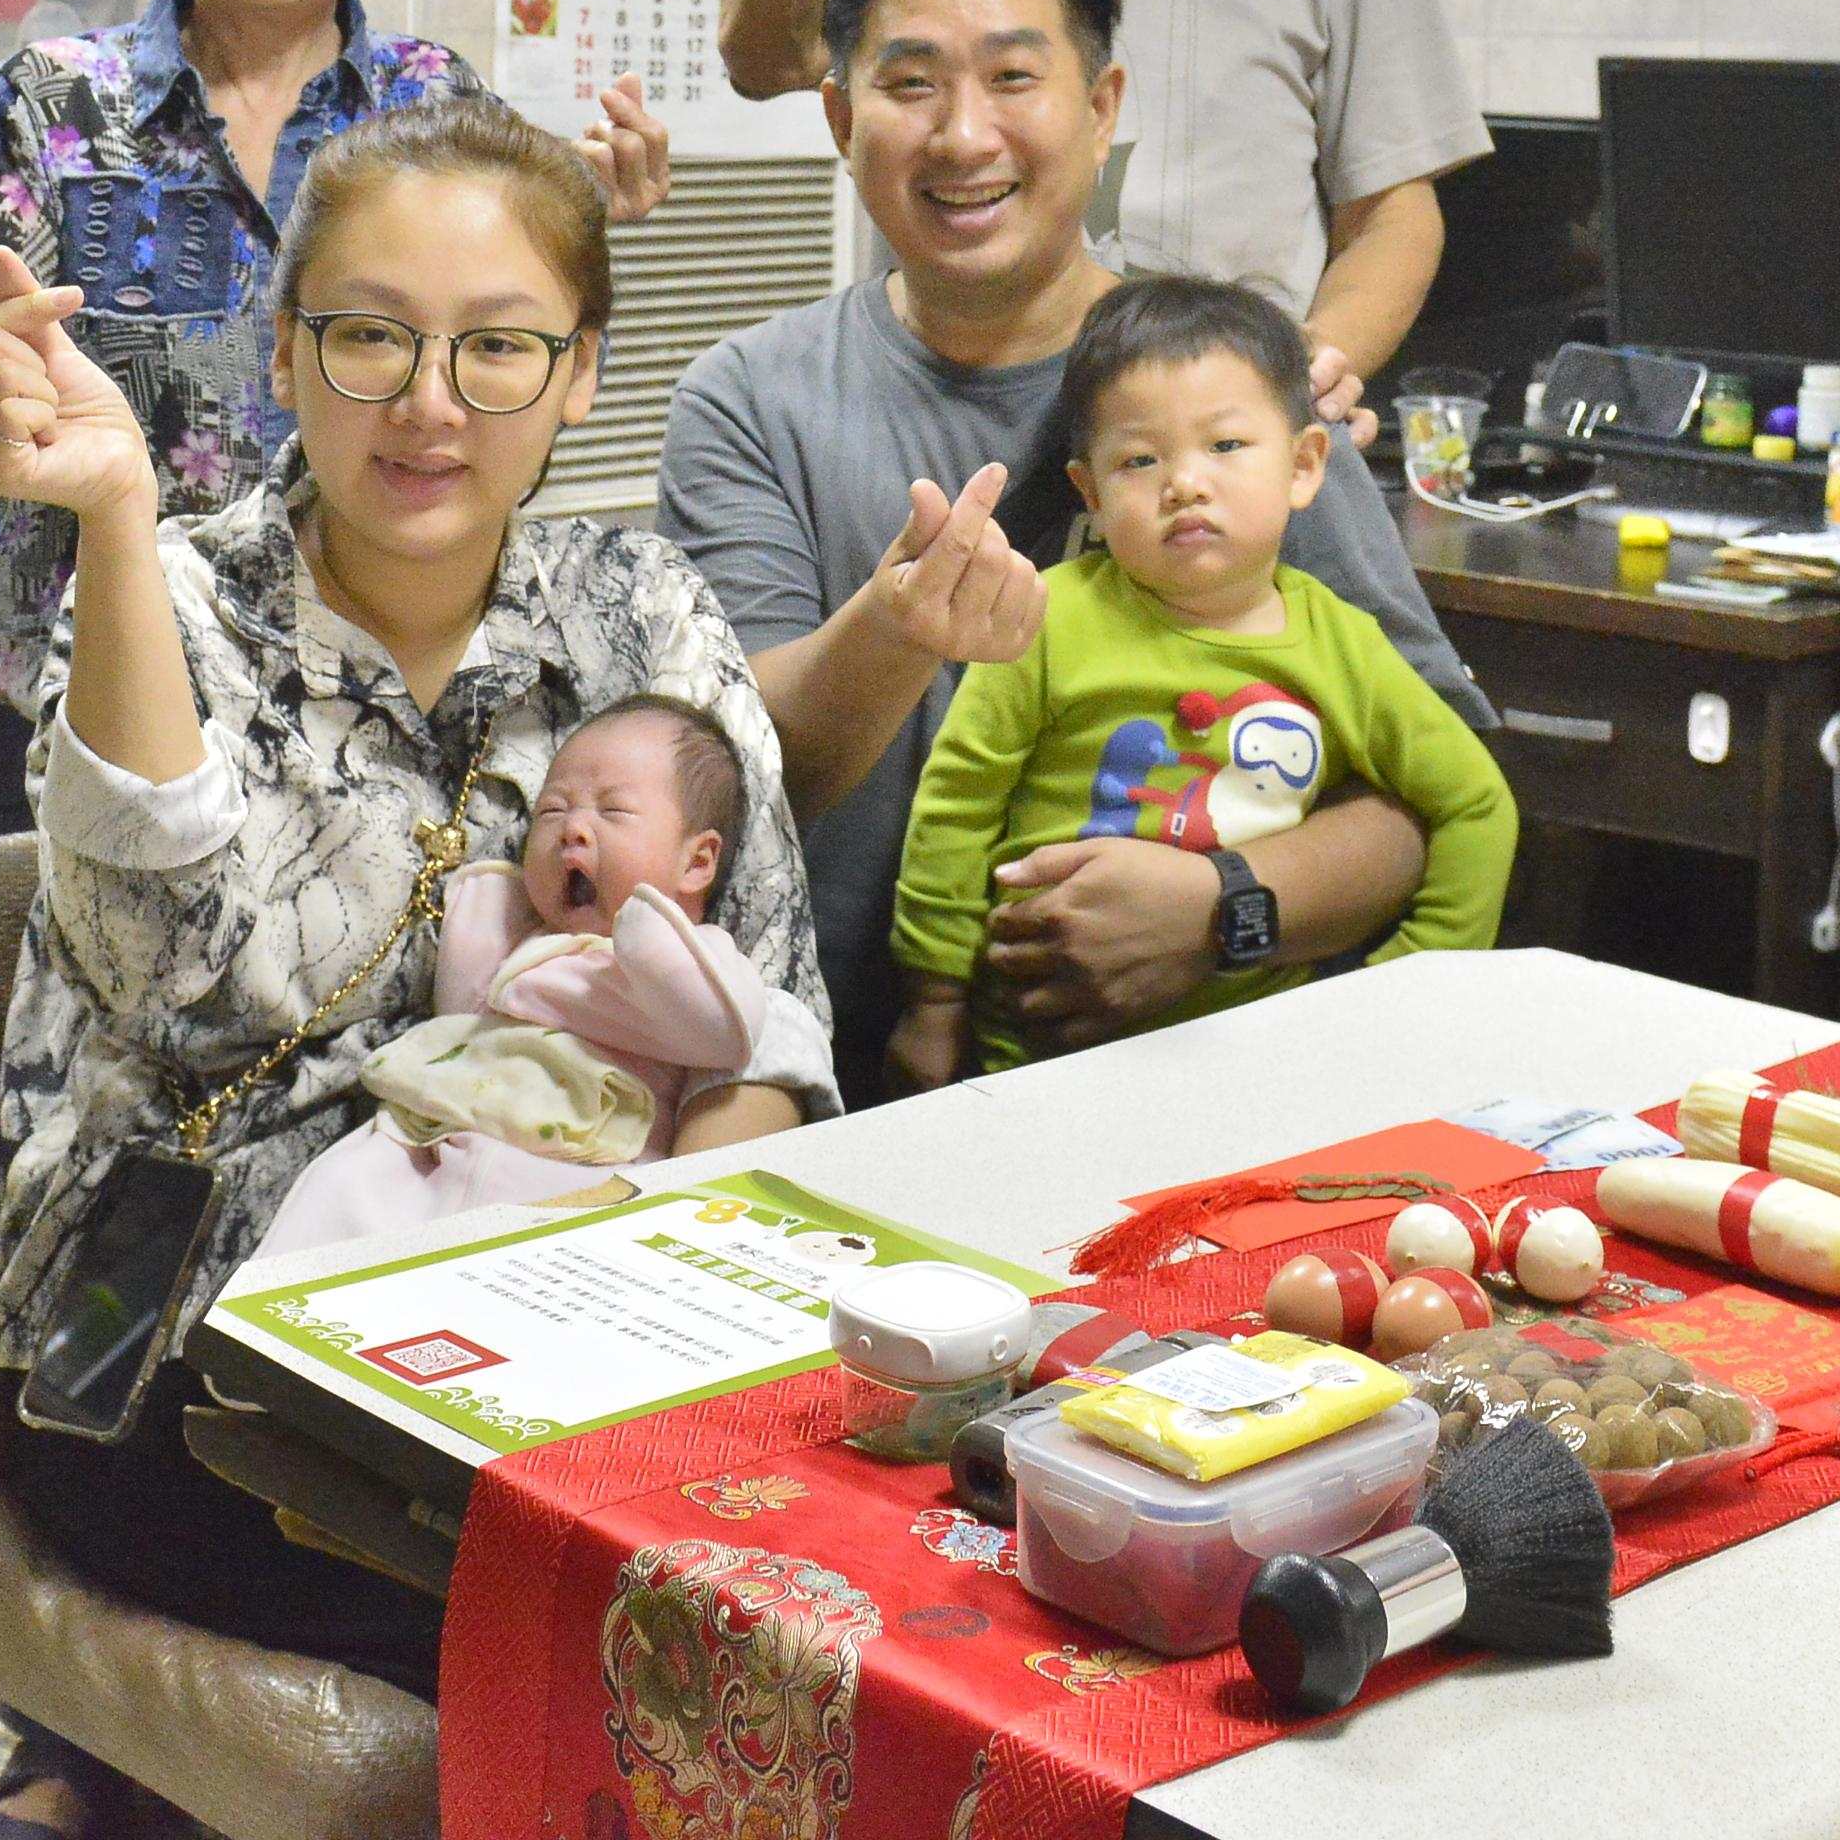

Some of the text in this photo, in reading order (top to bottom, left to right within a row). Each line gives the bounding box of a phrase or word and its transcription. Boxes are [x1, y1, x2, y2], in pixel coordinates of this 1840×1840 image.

[575, 33, 705, 53] 14 15 16 17
[575, 58, 593, 76] 21
